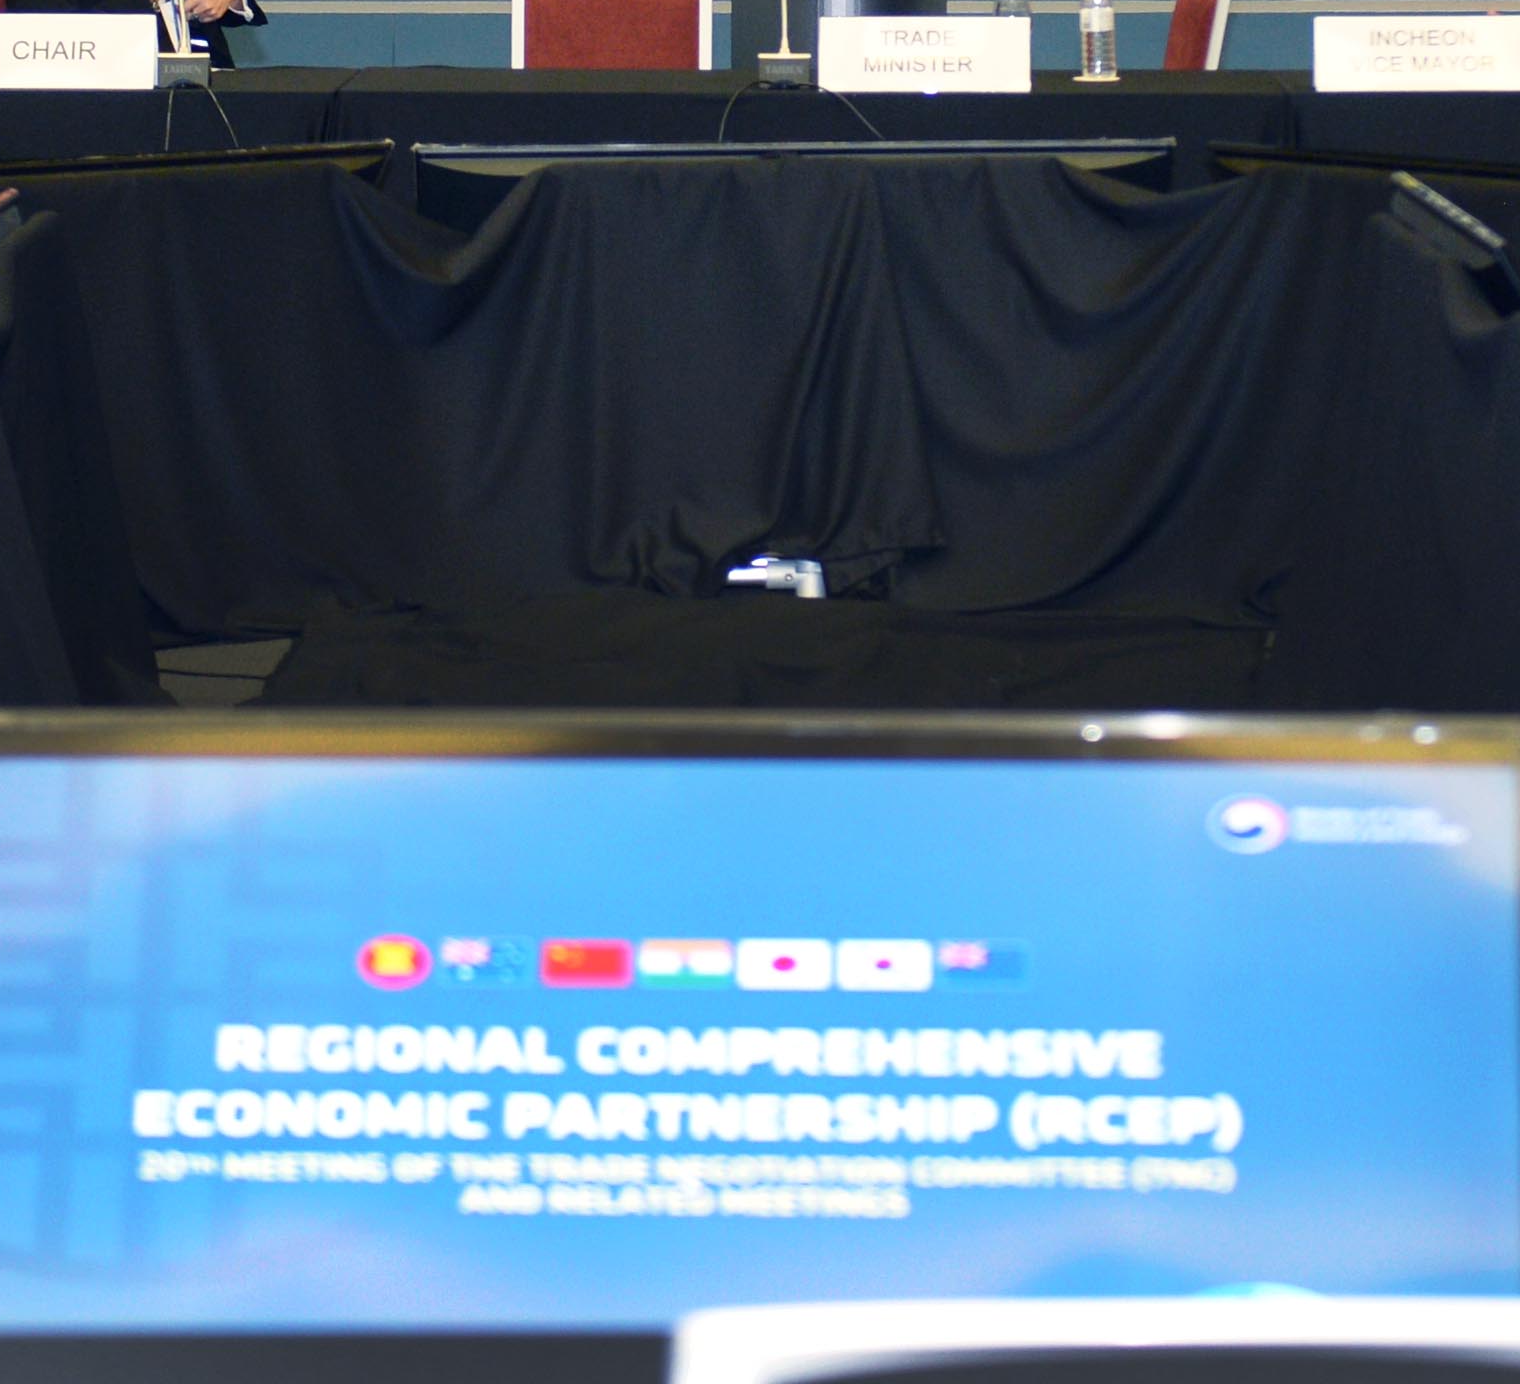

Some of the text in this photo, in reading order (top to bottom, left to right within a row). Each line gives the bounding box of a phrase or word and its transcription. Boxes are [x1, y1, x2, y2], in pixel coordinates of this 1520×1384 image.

[12, 40, 97, 61] CHAIR
[880, 29, 956, 47] TRADE
[1369, 29, 1475, 47] INCHEON
[863, 56, 974, 73] MINISTER
[215, 1024, 1163, 1079] REGIONAL COMPREHENSIVE
[132, 1089, 1243, 1153] ECONOMIC PARTNERSHIP (RCEP)
[221, 1151, 387, 1183] MEETING
[391, 1153, 442, 1183] OF
[448, 1153, 522, 1183] THE
[528, 1154, 650, 1184] TRADE
[910, 1156, 1127, 1189] COMMITTEE
[458, 1183, 912, 1218] AND RELATED MEETINGS
